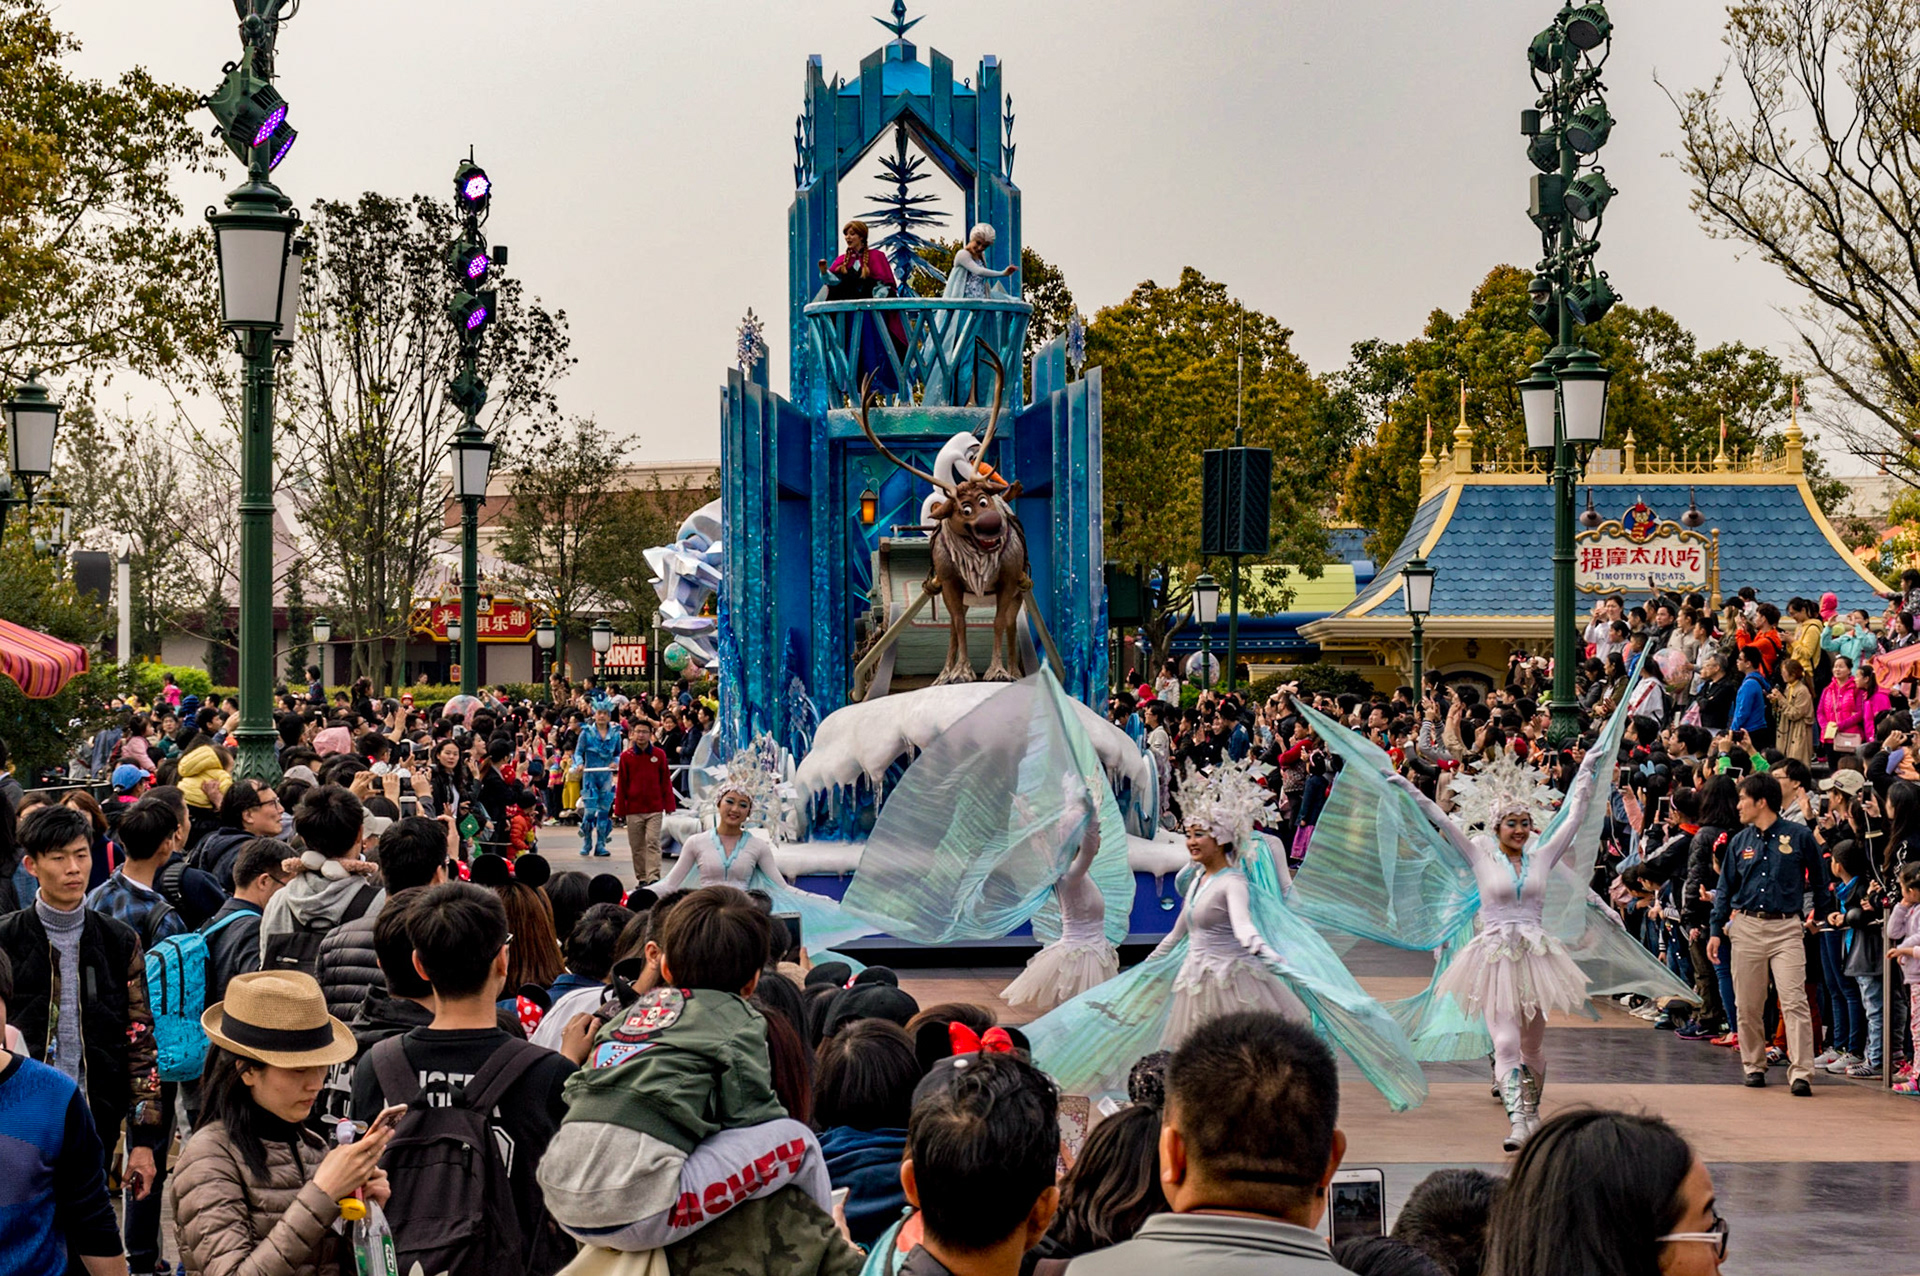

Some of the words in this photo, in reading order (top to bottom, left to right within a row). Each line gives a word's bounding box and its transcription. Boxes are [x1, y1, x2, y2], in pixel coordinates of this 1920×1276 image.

[1580, 547, 1701, 574] 提摩太小吃
[1595, 571, 1646, 581] TIMOTHY'S
[437, 609, 526, 633] 米俱乐部
